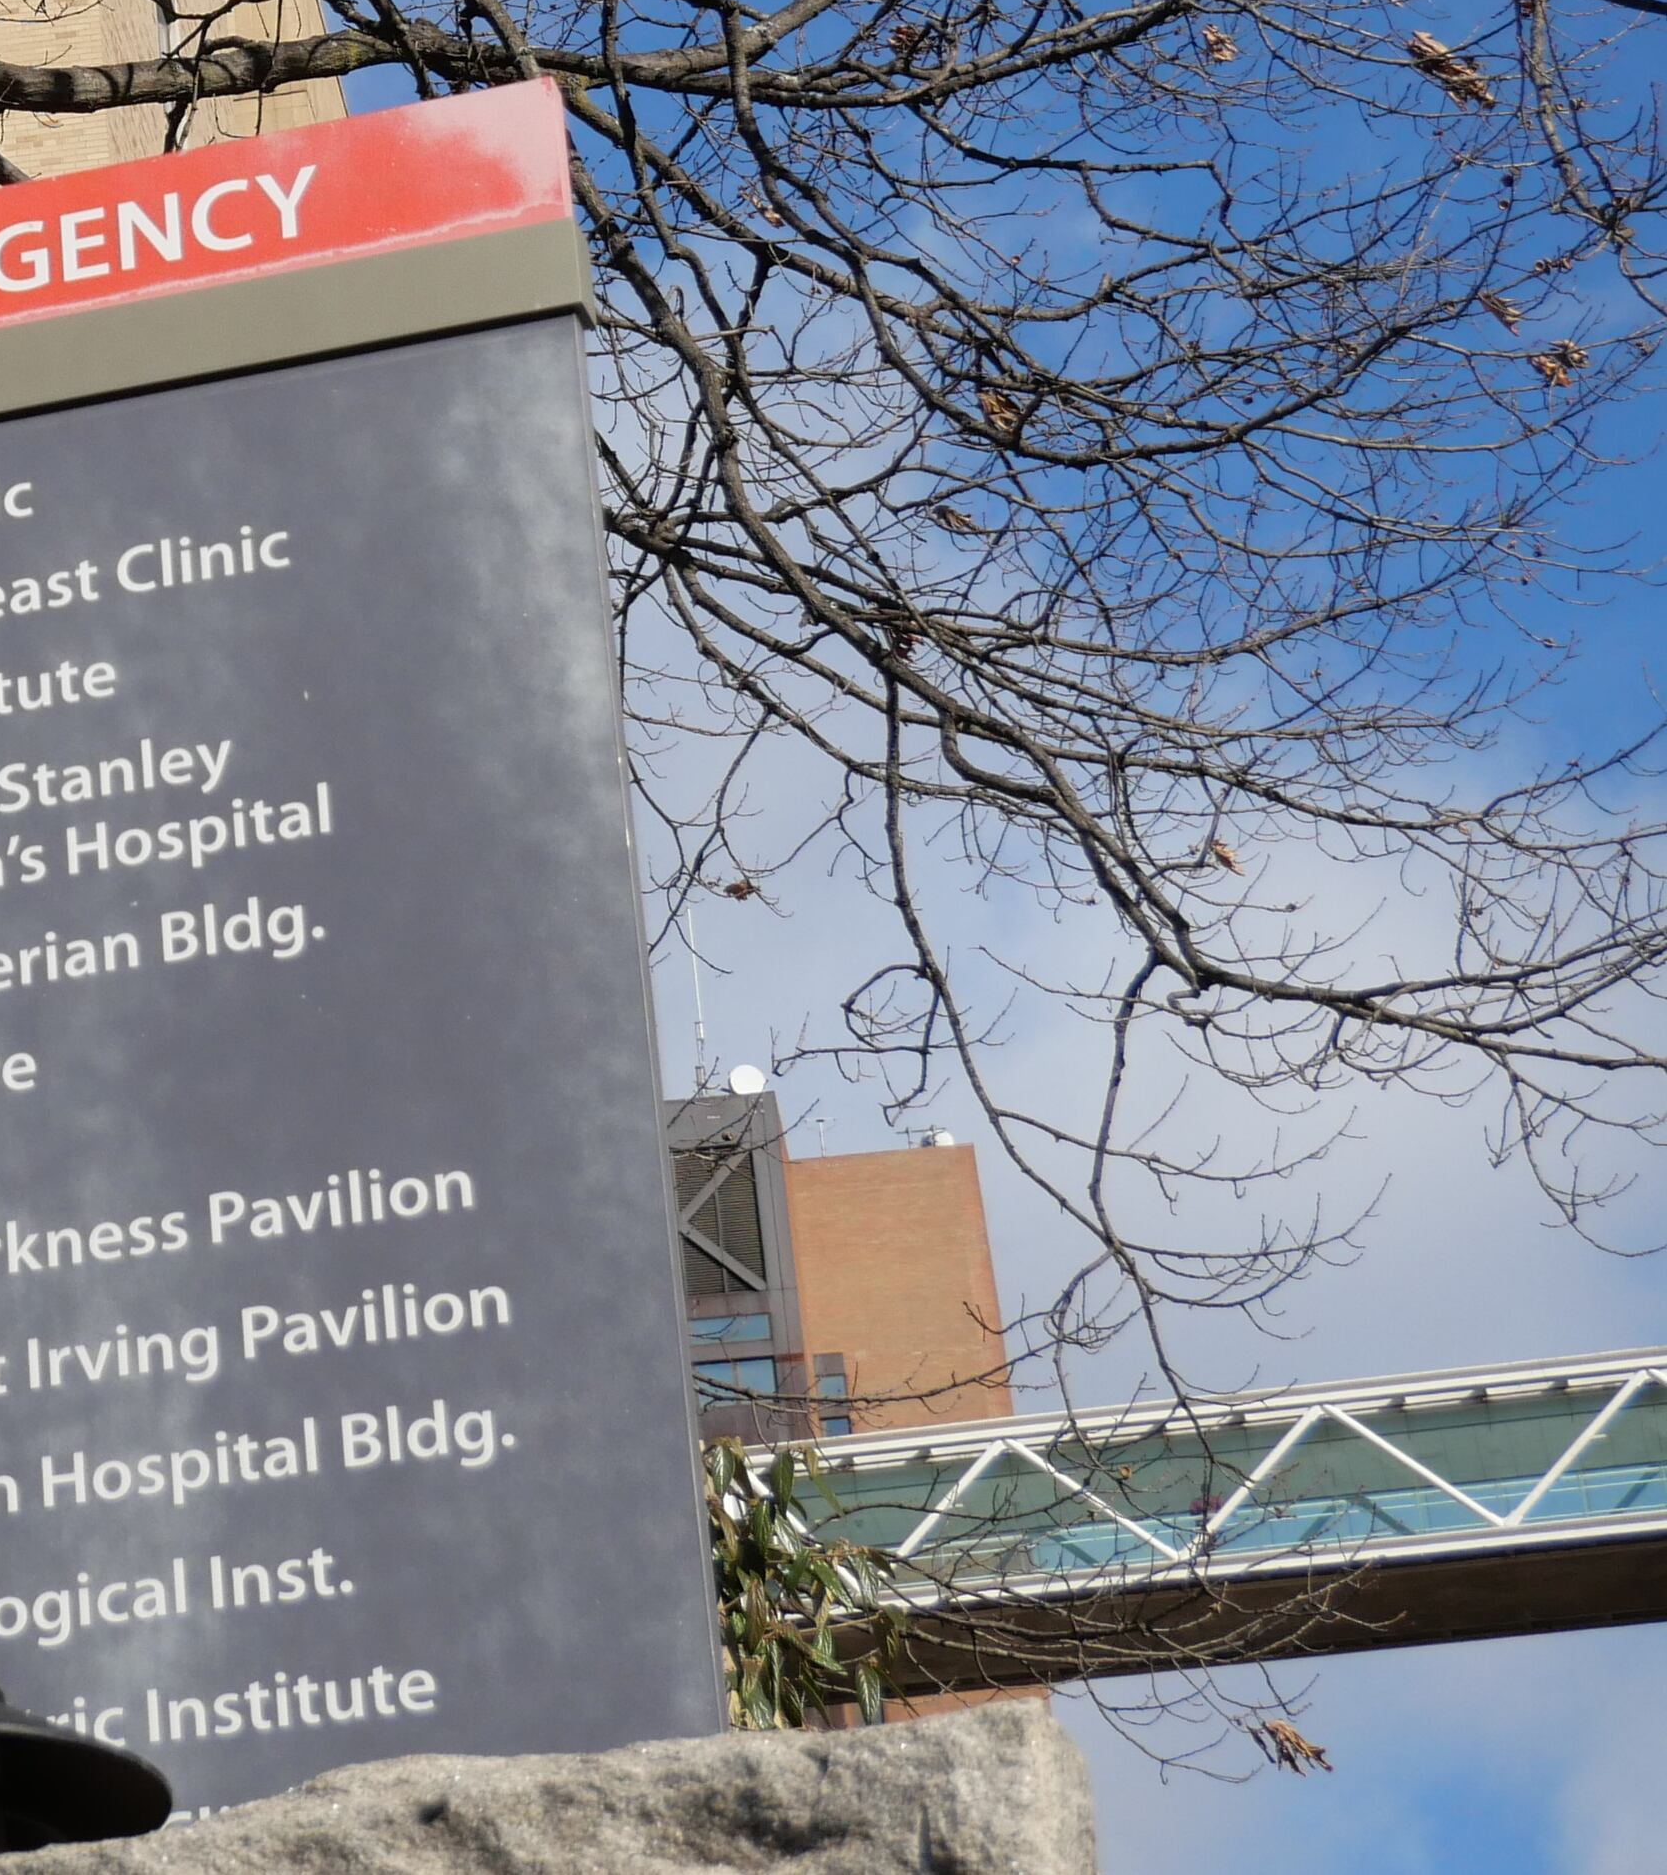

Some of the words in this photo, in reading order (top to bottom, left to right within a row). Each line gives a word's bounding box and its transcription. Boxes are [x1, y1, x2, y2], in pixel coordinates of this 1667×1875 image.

[117, 526, 290, 592] Clinic
[67, 782, 331, 874] Hospital
[161, 897, 325, 962] Bldg.
[210, 1168, 475, 1243] Pavilion
[28, 1325, 218, 1388] Irving
[242, 1284, 510, 1359] Pavilion
[42, 1417, 318, 1507] Hospital
[342, 1399, 515, 1468] Bldg.
[211, 1548, 353, 1608] Inst.
[147, 1666, 436, 1742] Institute
